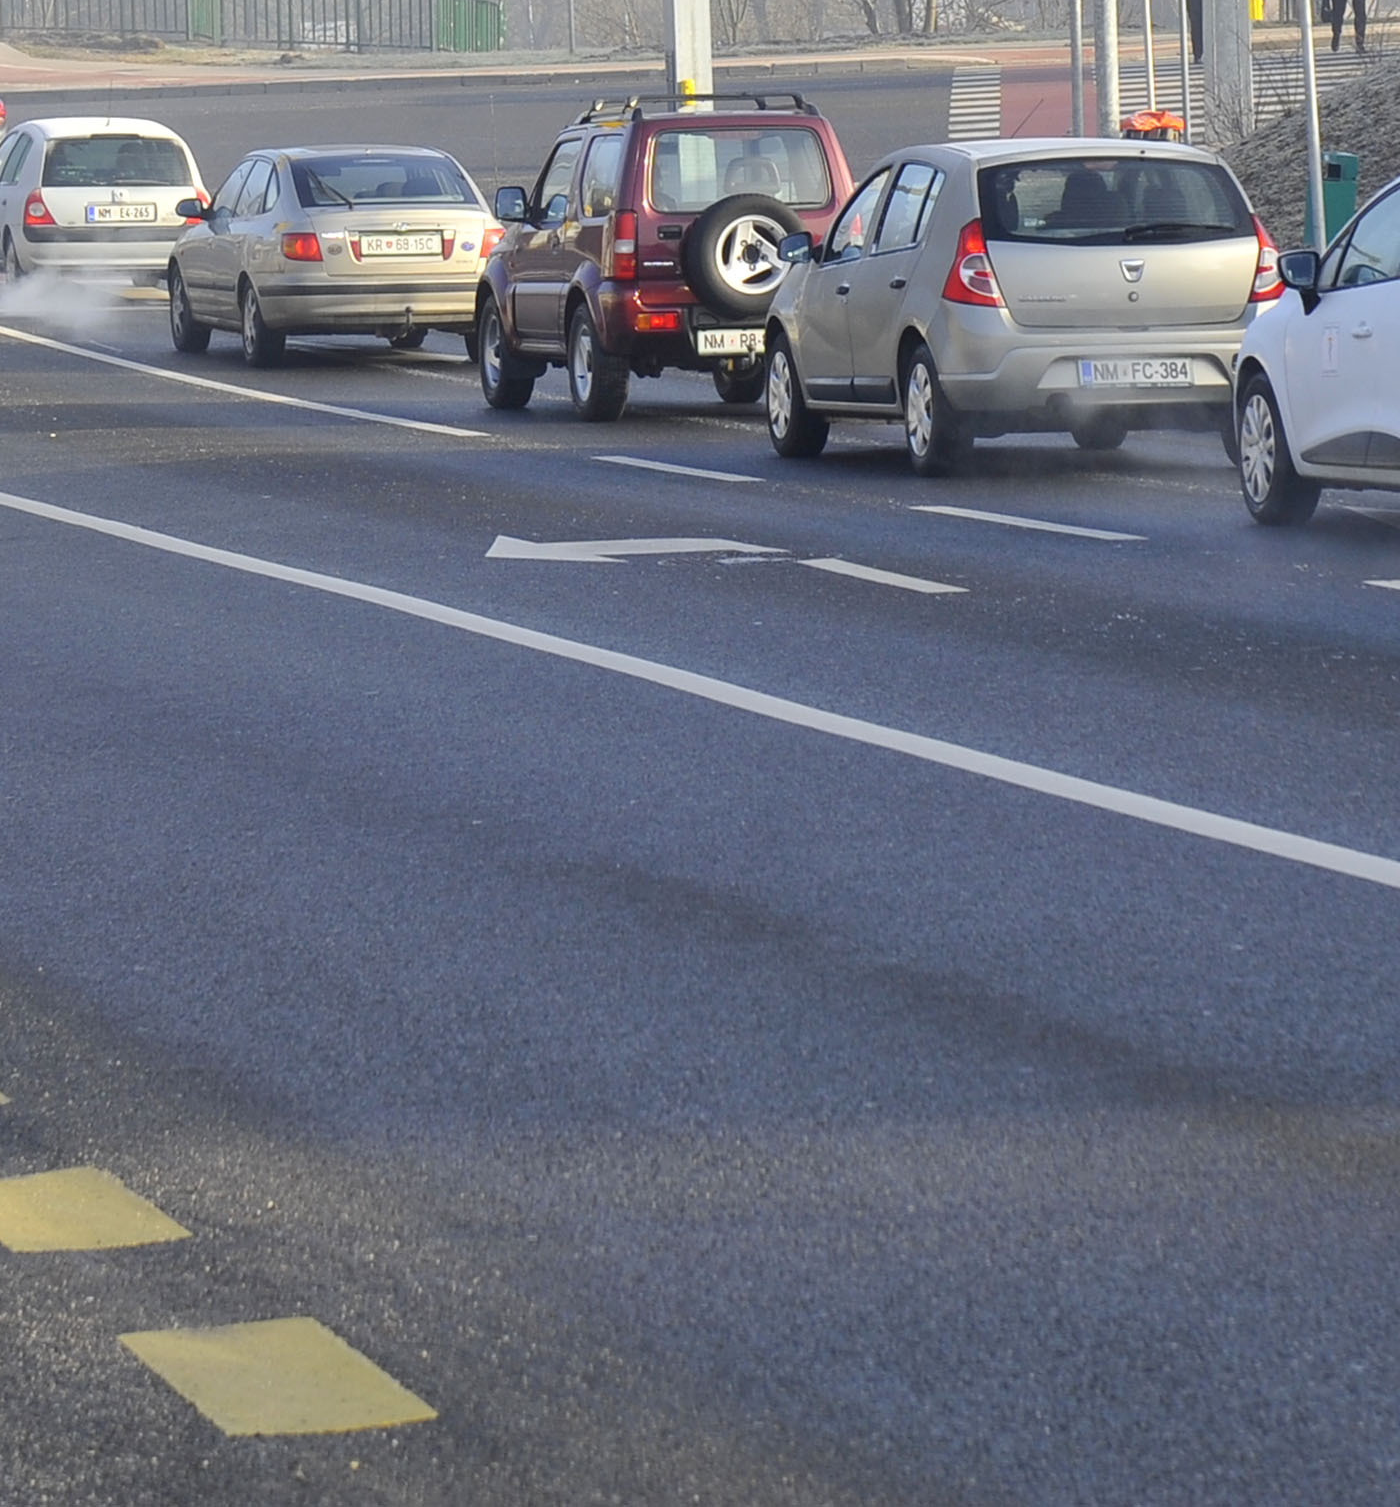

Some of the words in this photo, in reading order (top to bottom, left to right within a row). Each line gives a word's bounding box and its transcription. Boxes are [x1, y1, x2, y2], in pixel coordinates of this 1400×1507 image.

[98, 208, 111, 219] NM
[120, 207, 150, 219] E4-265
[367, 238, 383, 251] KR
[704, 334, 725, 349] NM
[1093, 363, 1119, 381] NM
[1131, 361, 1188, 380] FC-384
